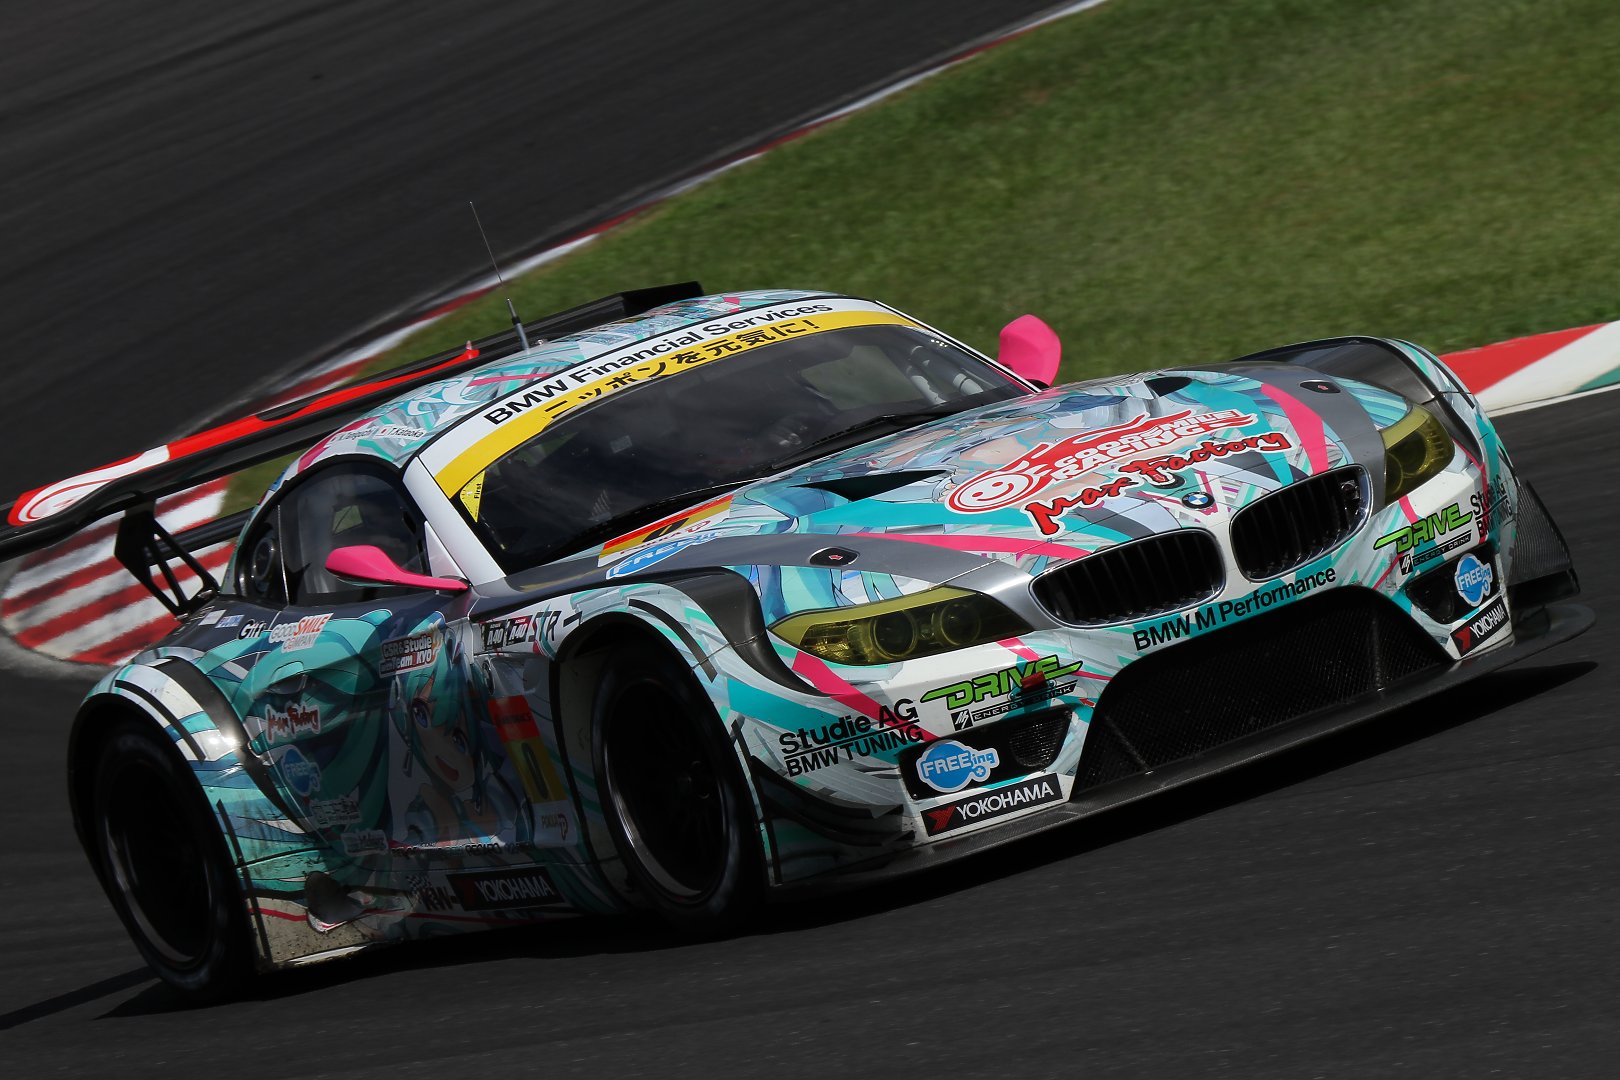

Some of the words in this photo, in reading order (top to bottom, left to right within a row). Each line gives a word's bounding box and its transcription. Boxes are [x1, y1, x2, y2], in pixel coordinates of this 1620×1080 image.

[484, 379, 569, 425] BMW
[577, 331, 704, 383] Financial
[702, 302, 833, 336] Services
[1051, 423, 1207, 481] RACING
[473, 483, 482, 499] First
[1024, 477, 1139, 536] Max
[1117, 432, 1293, 484] Factory
[1373, 503, 1474, 554] DRIVE
[1448, 535, 1471, 550] DRINK
[293, 614, 331, 636] SMILE
[1132, 613, 1191, 651] BMW
[1194, 607, 1217, 631] M
[1218, 567, 1337, 623] Performance
[1469, 604, 1506, 639] YOKOHAMA
[920, 655, 1084, 710] DRIVE
[778, 711, 871, 755] Studie
[878, 698, 918, 729] AG
[785, 746, 840, 777] BMW
[845, 725, 924, 761] TUNING
[921, 751, 997, 777] FREEing
[955, 781, 1055, 820] YOKOHAMA
[475, 875, 555, 904] YOKOHAMA
